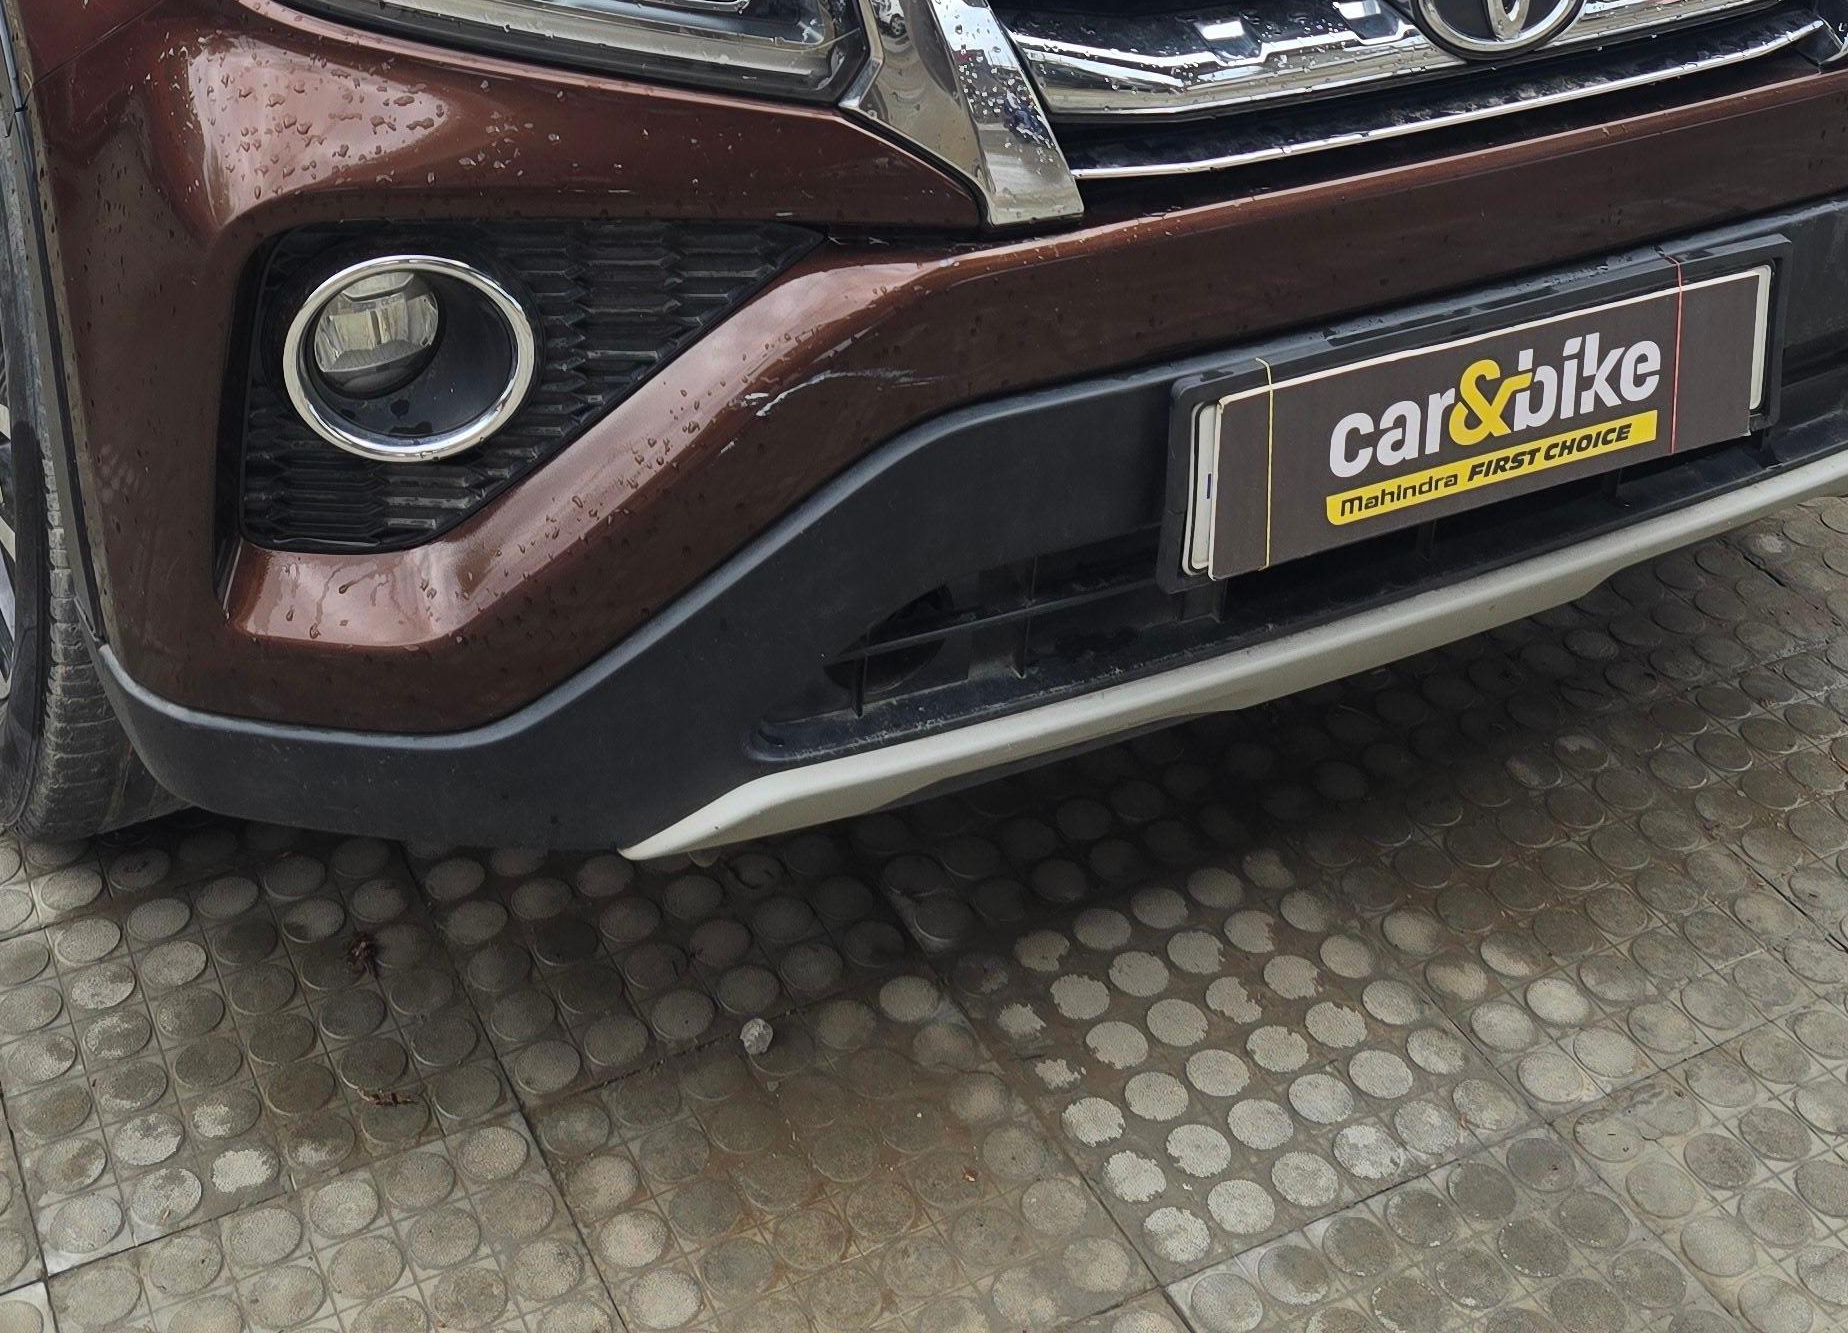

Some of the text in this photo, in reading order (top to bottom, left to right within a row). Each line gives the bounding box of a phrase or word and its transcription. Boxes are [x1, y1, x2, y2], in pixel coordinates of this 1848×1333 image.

[1329, 332, 1662, 478] car&bike
[1340, 423, 1633, 518] Mahindra FIRST CHOICE
